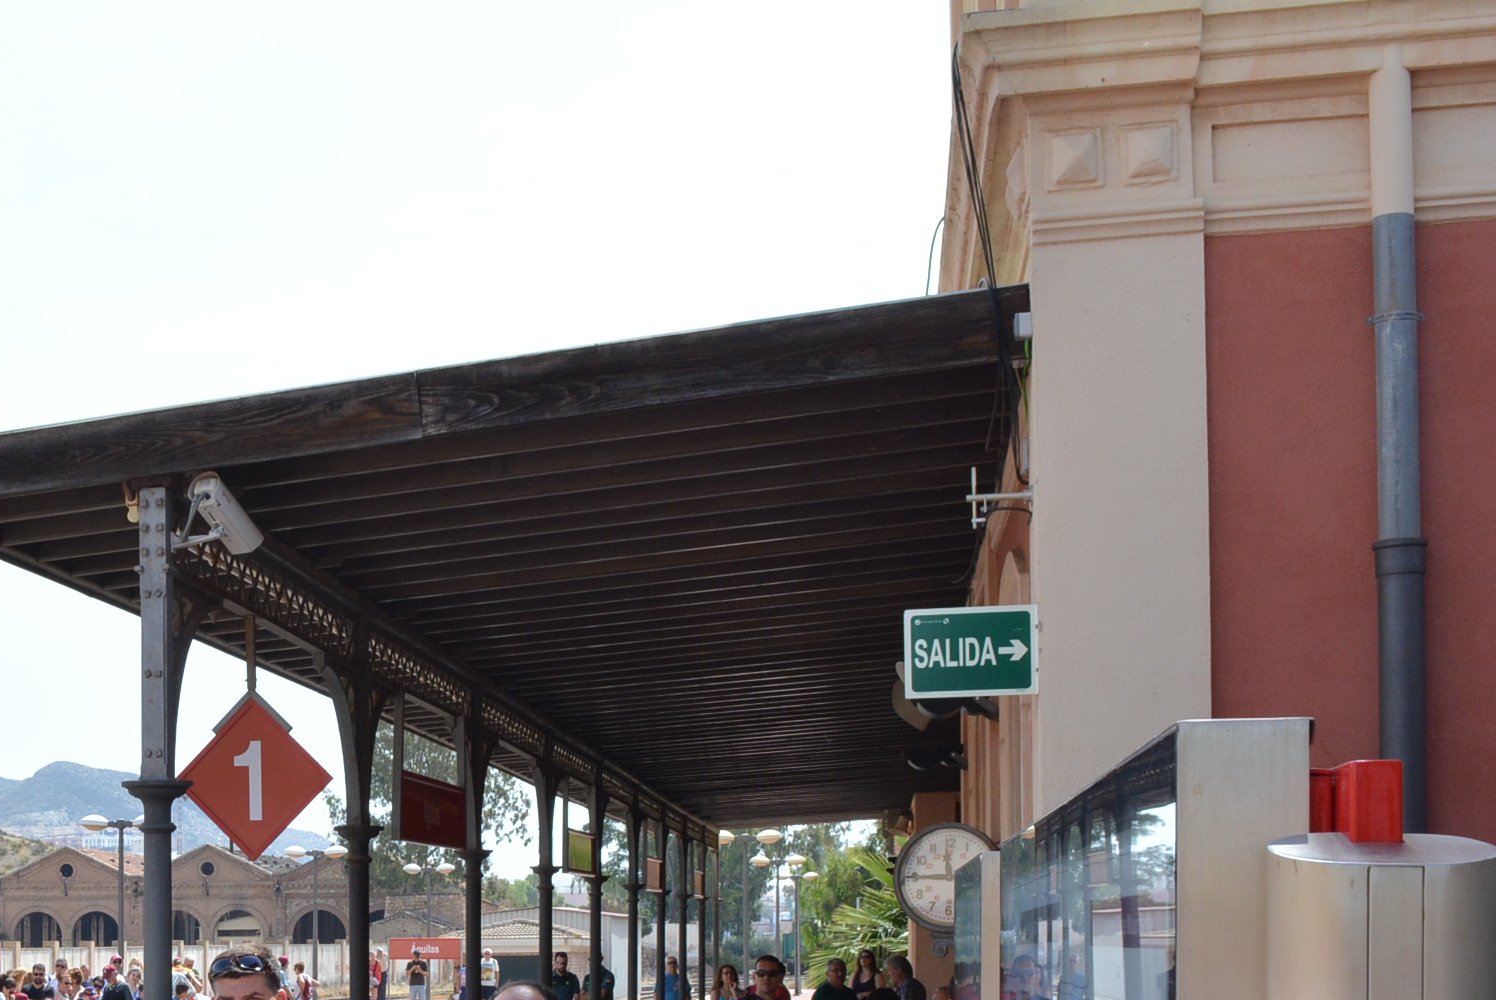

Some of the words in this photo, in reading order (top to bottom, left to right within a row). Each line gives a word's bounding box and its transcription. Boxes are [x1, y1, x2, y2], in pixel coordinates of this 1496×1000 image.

[914, 637, 997, 668] SALIDA
[234, 741, 262, 821] 1
[916, 856, 927, 866] 10
[916, 889, 924, 900] 8
[928, 901, 936, 911] 7
[945, 905, 952, 916] 6
